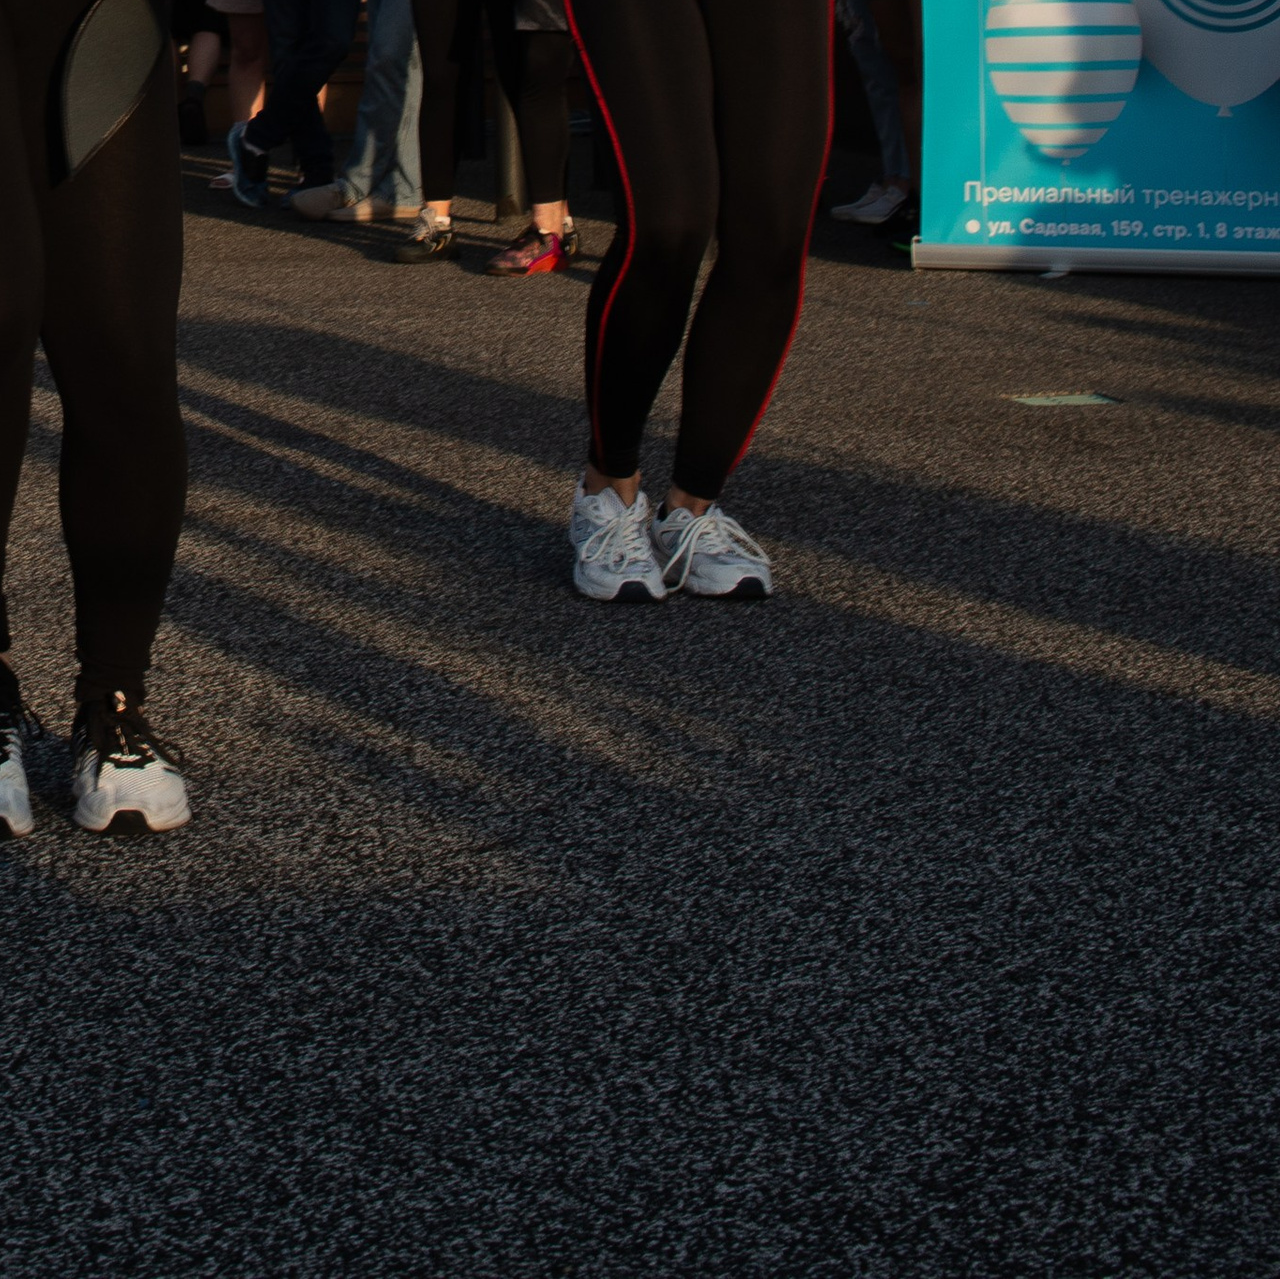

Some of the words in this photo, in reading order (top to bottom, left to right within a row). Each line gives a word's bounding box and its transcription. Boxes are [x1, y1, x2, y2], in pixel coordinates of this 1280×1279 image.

[964, 181, 1135, 206] Премиальный
[988, 221, 1015, 236] ул.
[1020, 218, 1106, 238] Садовая,
[1111, 220, 1148, 239] 159,
[1153, 224, 1192, 241] стр.
[1215, 222, 1227, 238] 8
